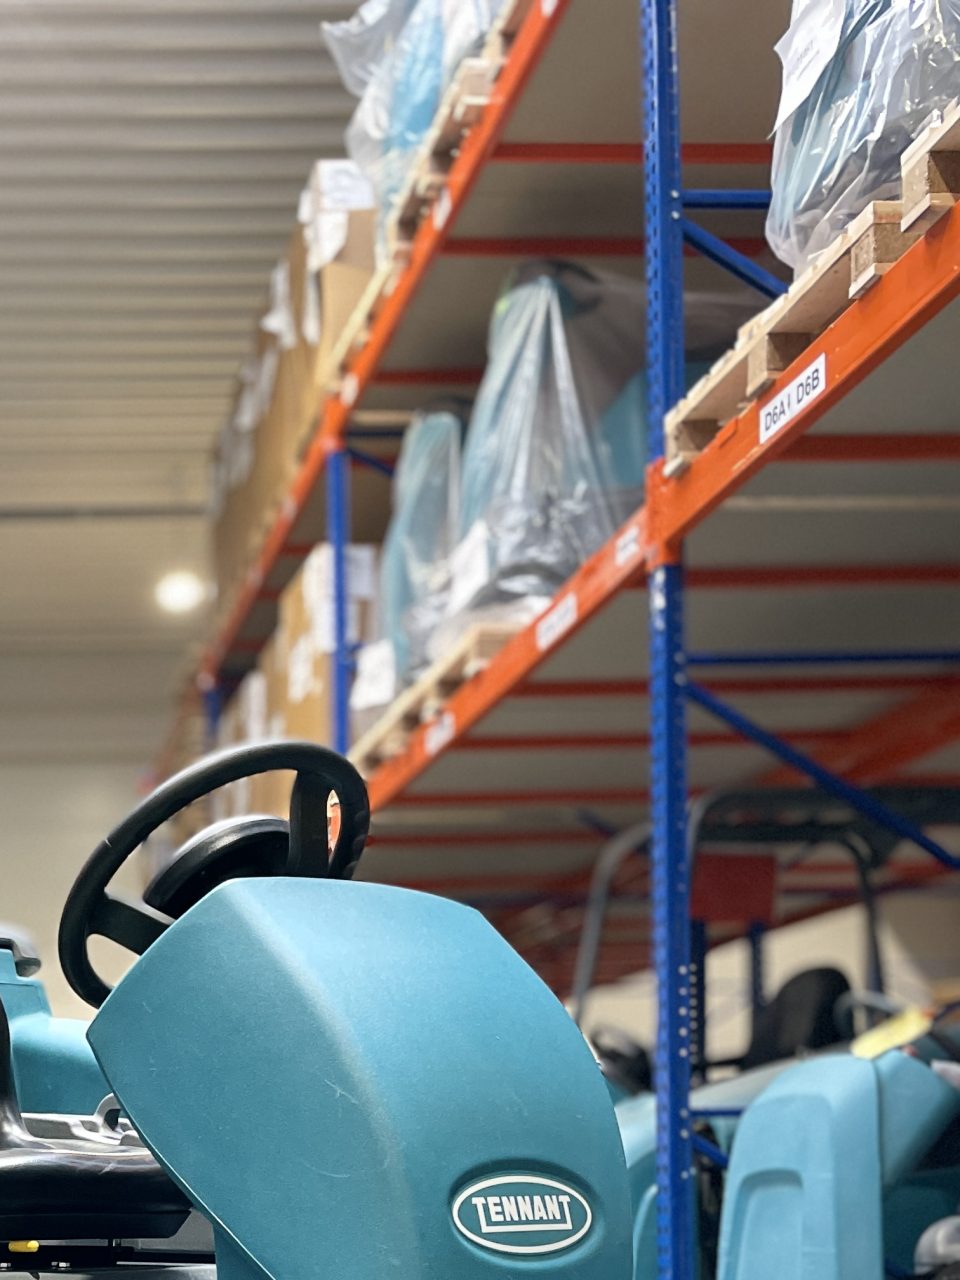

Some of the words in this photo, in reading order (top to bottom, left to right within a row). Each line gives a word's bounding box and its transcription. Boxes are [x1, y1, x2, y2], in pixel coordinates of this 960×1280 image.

[765, 400, 786, 431] D6A
[797, 368, 820, 404] D6B
[472, 1195, 573, 1233] TENNANT
